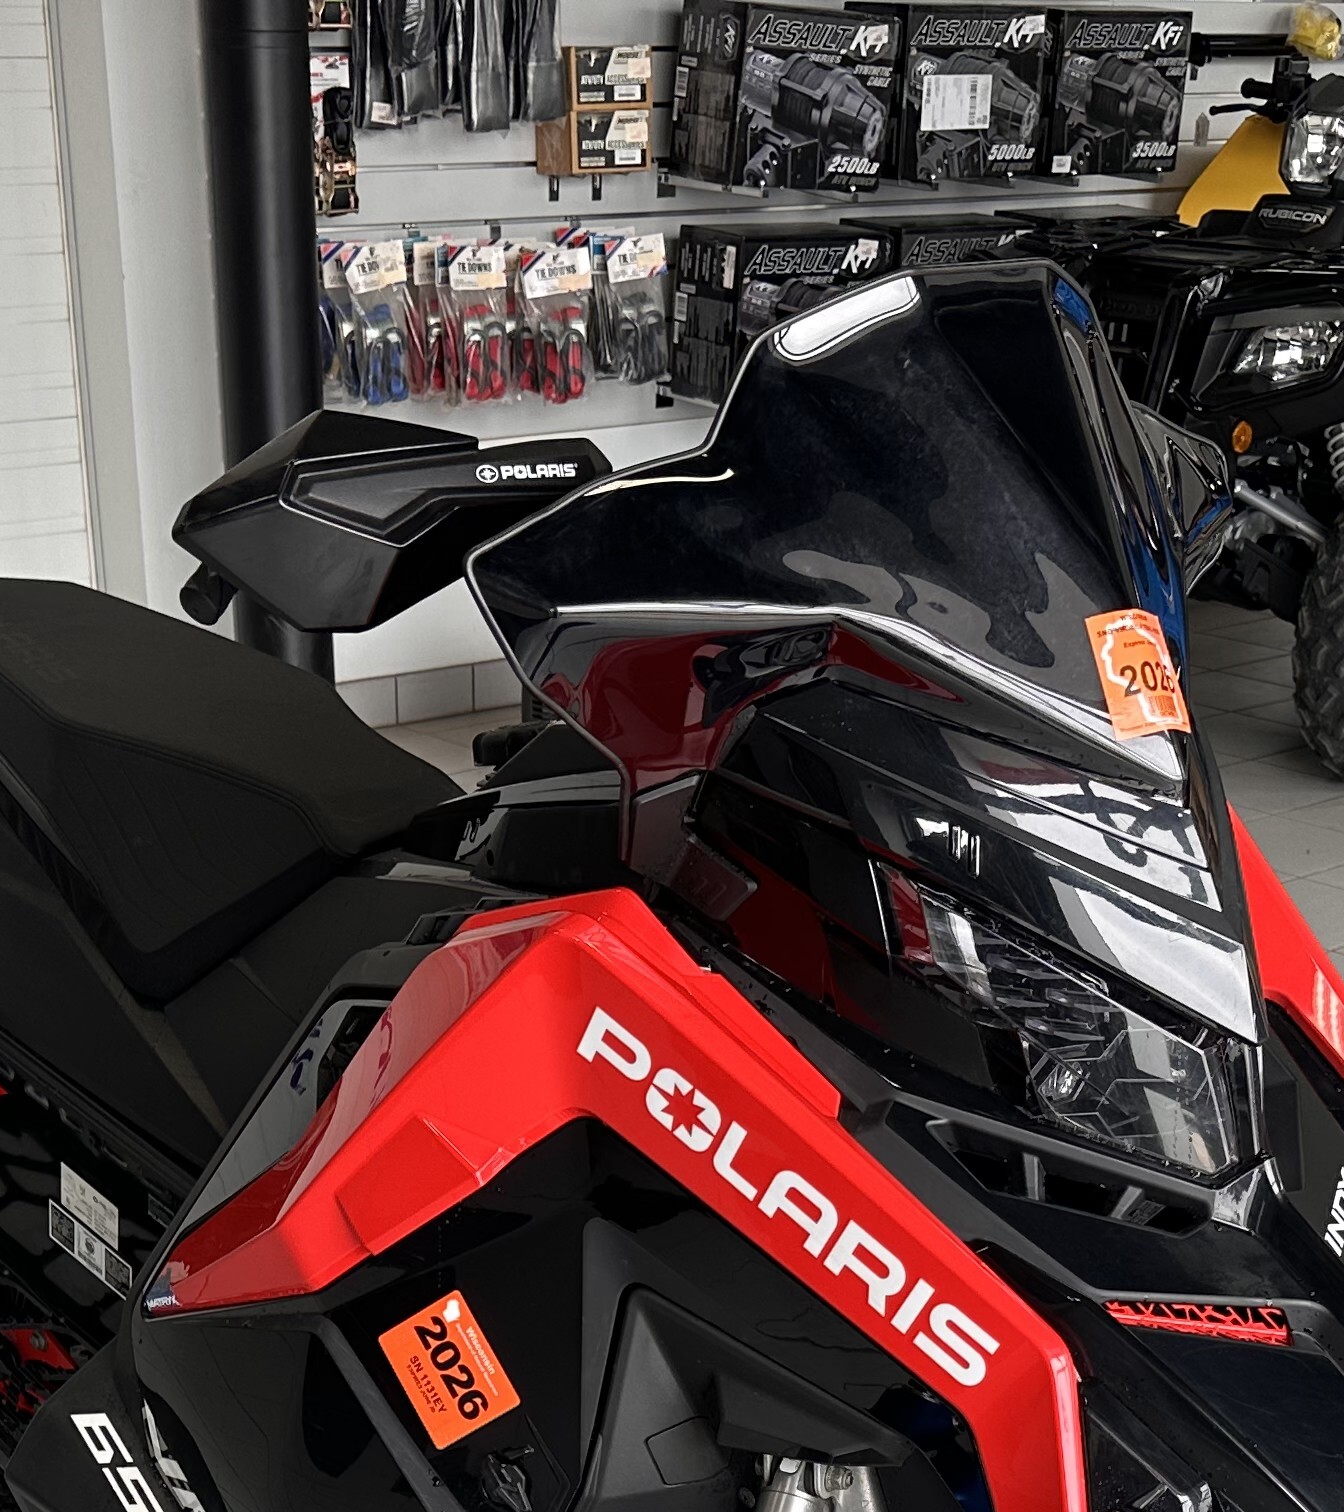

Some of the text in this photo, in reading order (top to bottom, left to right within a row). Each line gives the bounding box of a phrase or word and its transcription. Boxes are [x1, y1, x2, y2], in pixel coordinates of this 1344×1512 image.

[748, 14, 854, 50] ASSAULT
[910, 15, 1006, 46] ASSAULT
[1065, 19, 1156, 48] ASSAULT
[1151, 21, 1184, 51] KFi
[988, 144, 1035, 161] 5000LB
[1132, 141, 1176, 158] 3500LB
[828, 155, 880, 175] 2500LB
[1258, 208, 1328, 225] RUBICON
[745, 245, 845, 275] ASSAULT
[500, 463, 576, 480] POLARIS
[576, 1006, 1000, 1387] POLARIS
[409, 1355, 424, 1373] SN
[466, 1326, 495, 1375] Wisconsin
[414, 1316, 489, 1420] 2026
